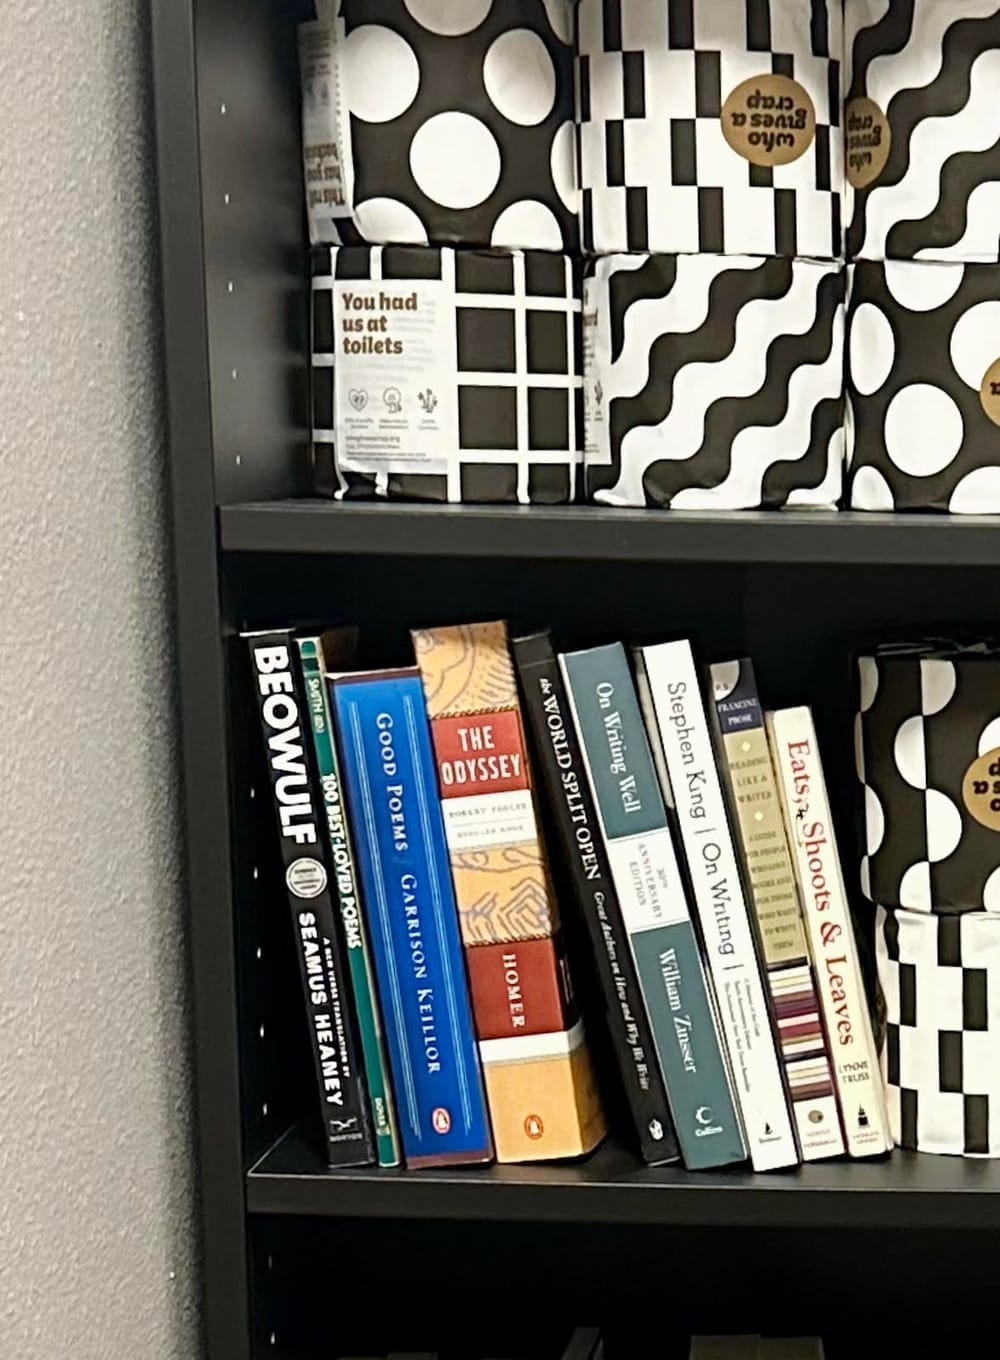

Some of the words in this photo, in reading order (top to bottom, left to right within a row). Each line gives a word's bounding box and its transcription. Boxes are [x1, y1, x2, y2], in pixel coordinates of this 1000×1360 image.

[747, 90, 794, 111] crap
[731, 112, 747, 127] a
[751, 109, 807, 130] gives
[748, 131, 795, 153] who
[342, 292, 375, 310] You
[379, 292, 418, 310] had
[342, 316, 364, 332] us
[367, 315, 388, 332] at
[342, 336, 404, 354] toilets
[596, 682, 614, 709] On
[254, 646, 317, 844] BEOWULF
[457, 725, 495, 752] THE
[603, 711, 627, 775] Writing
[668, 682, 696, 766] Stephen
[686, 769, 707, 820] King
[377, 712, 396, 776] GOOD
[387, 784, 408, 851] POEMS
[441, 753, 520, 785] ODYSSEY
[320, 773, 338, 802] 100
[619, 775, 642, 813] Well
[326, 805, 353, 893] BEST-LOVED
[702, 842, 722, 876] On
[341, 898, 362, 949] POEMS
[709, 878, 736, 956] Writing
[400, 874, 427, 979] GARRISON
[417, 987, 441, 1073] KEILLOR
[502, 954, 525, 1028] HOMER
[299, 912, 328, 1005] SEAMUS
[314, 1014, 344, 1106] HEANEY
[659, 948, 682, 1012] William
[674, 1014, 697, 1074] Zinsser
